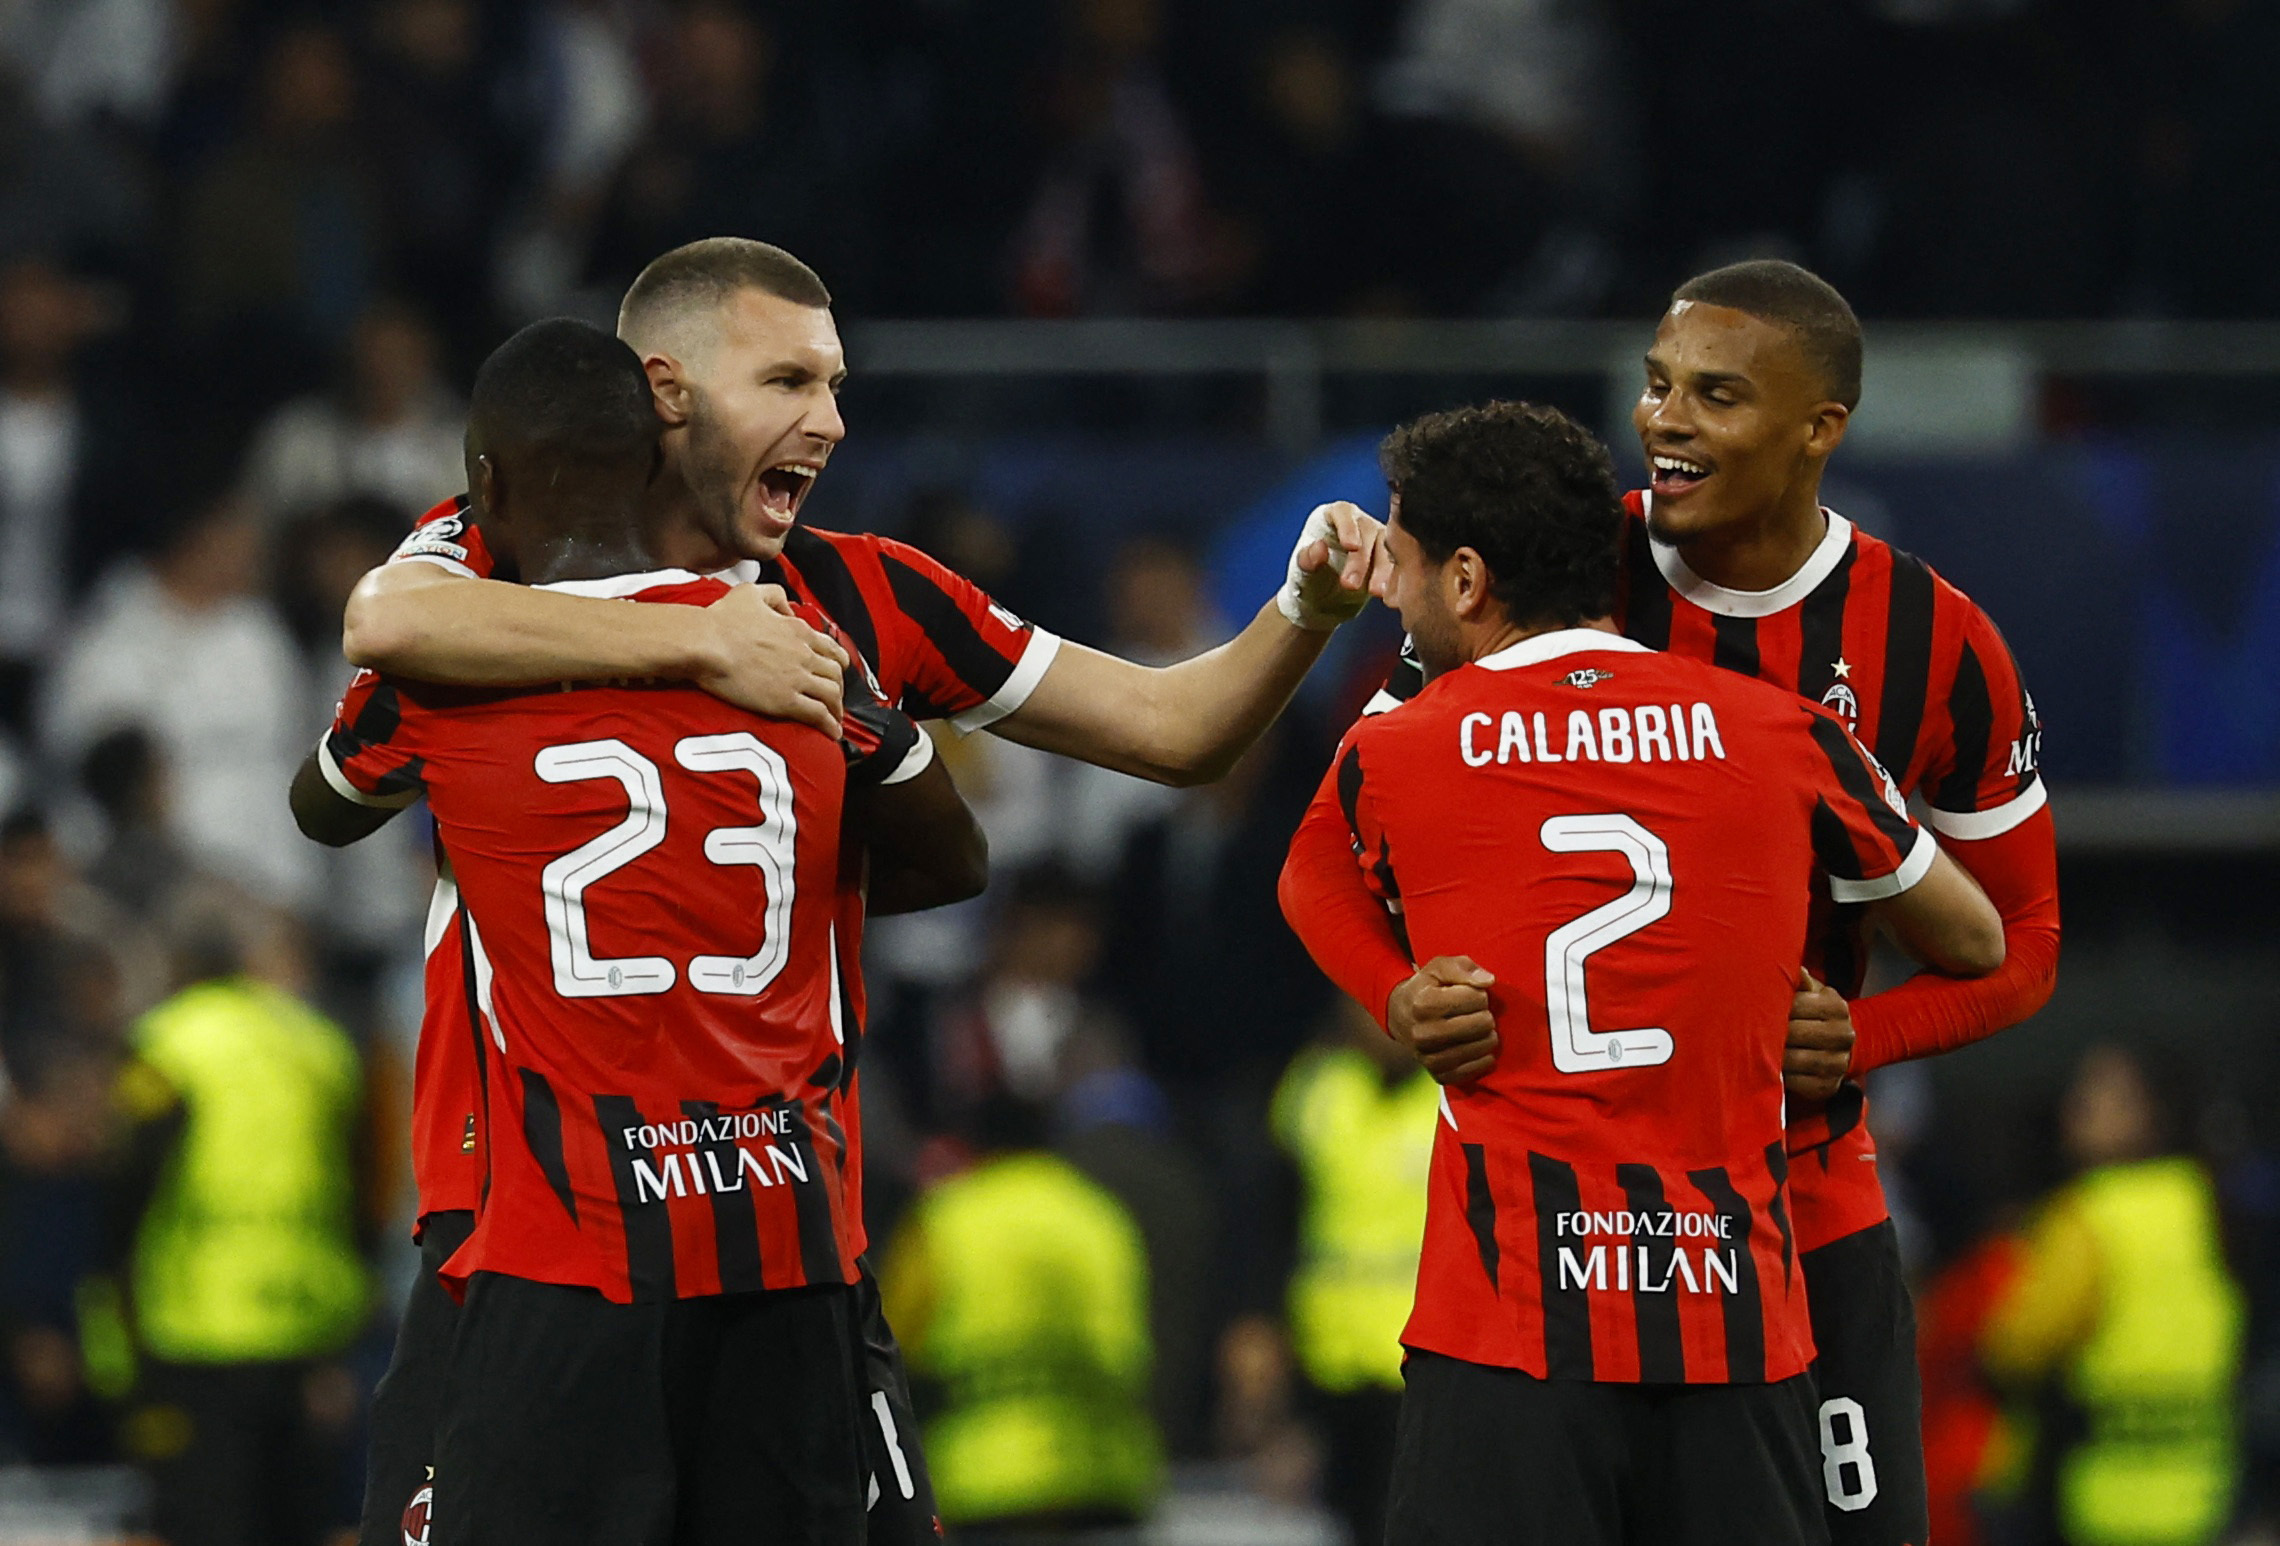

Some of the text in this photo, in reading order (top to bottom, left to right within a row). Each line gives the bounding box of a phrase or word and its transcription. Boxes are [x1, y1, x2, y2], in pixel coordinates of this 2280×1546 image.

[1566, 668, 1599, 686] 125
[1460, 703, 1726, 768] CALABRIA
[534, 731, 797, 998] 23
[1540, 813, 1674, 1073] 2
[623, 1109, 792, 1151] FONDAZIONE
[631, 1142, 809, 1204] MILAN
[1556, 1211, 1733, 1239] FONDAZIONE
[1557, 1245, 1739, 1294] MILAN
[866, 1390, 915, 1512] 1
